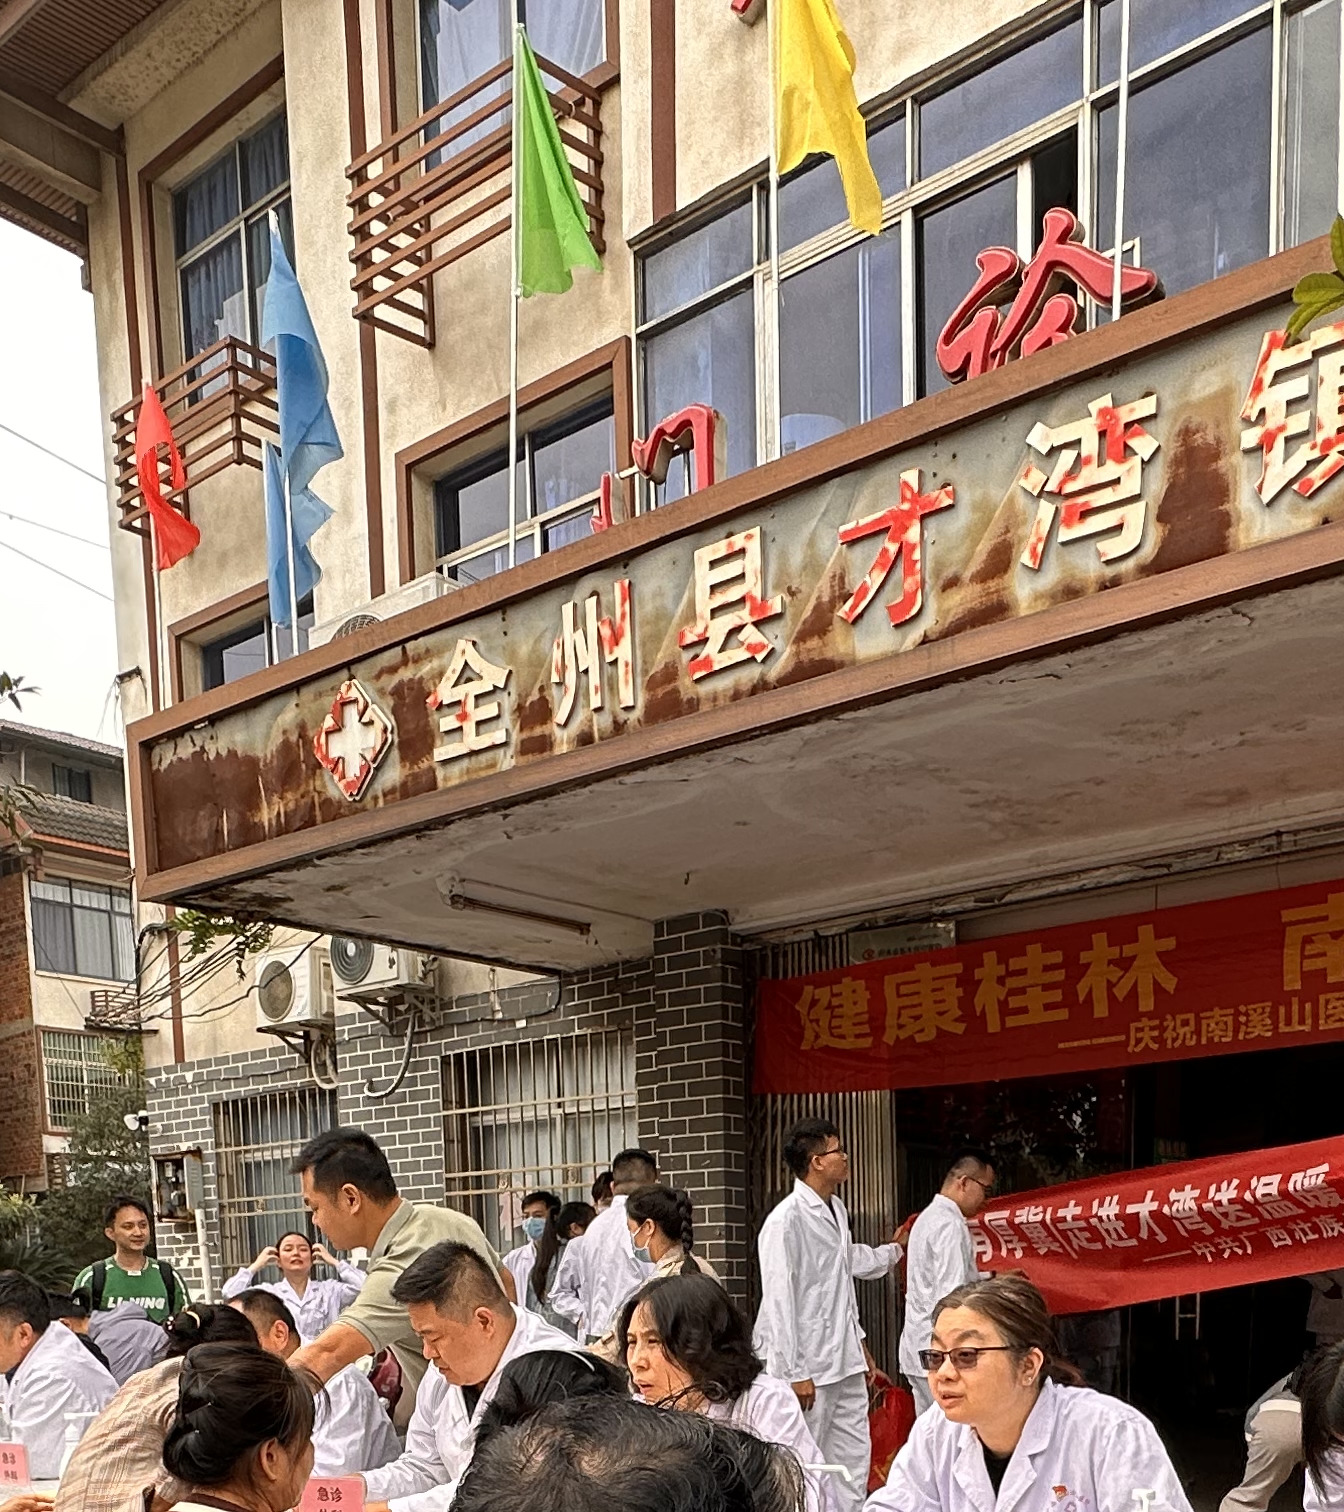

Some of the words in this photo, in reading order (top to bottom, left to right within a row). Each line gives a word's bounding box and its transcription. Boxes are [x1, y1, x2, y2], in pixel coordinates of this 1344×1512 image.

[795, 924, 1179, 1051] 健康桂林
[107, 1296, 166, 1310] LINING
[317, 1486, 343, 1503] 急诊
